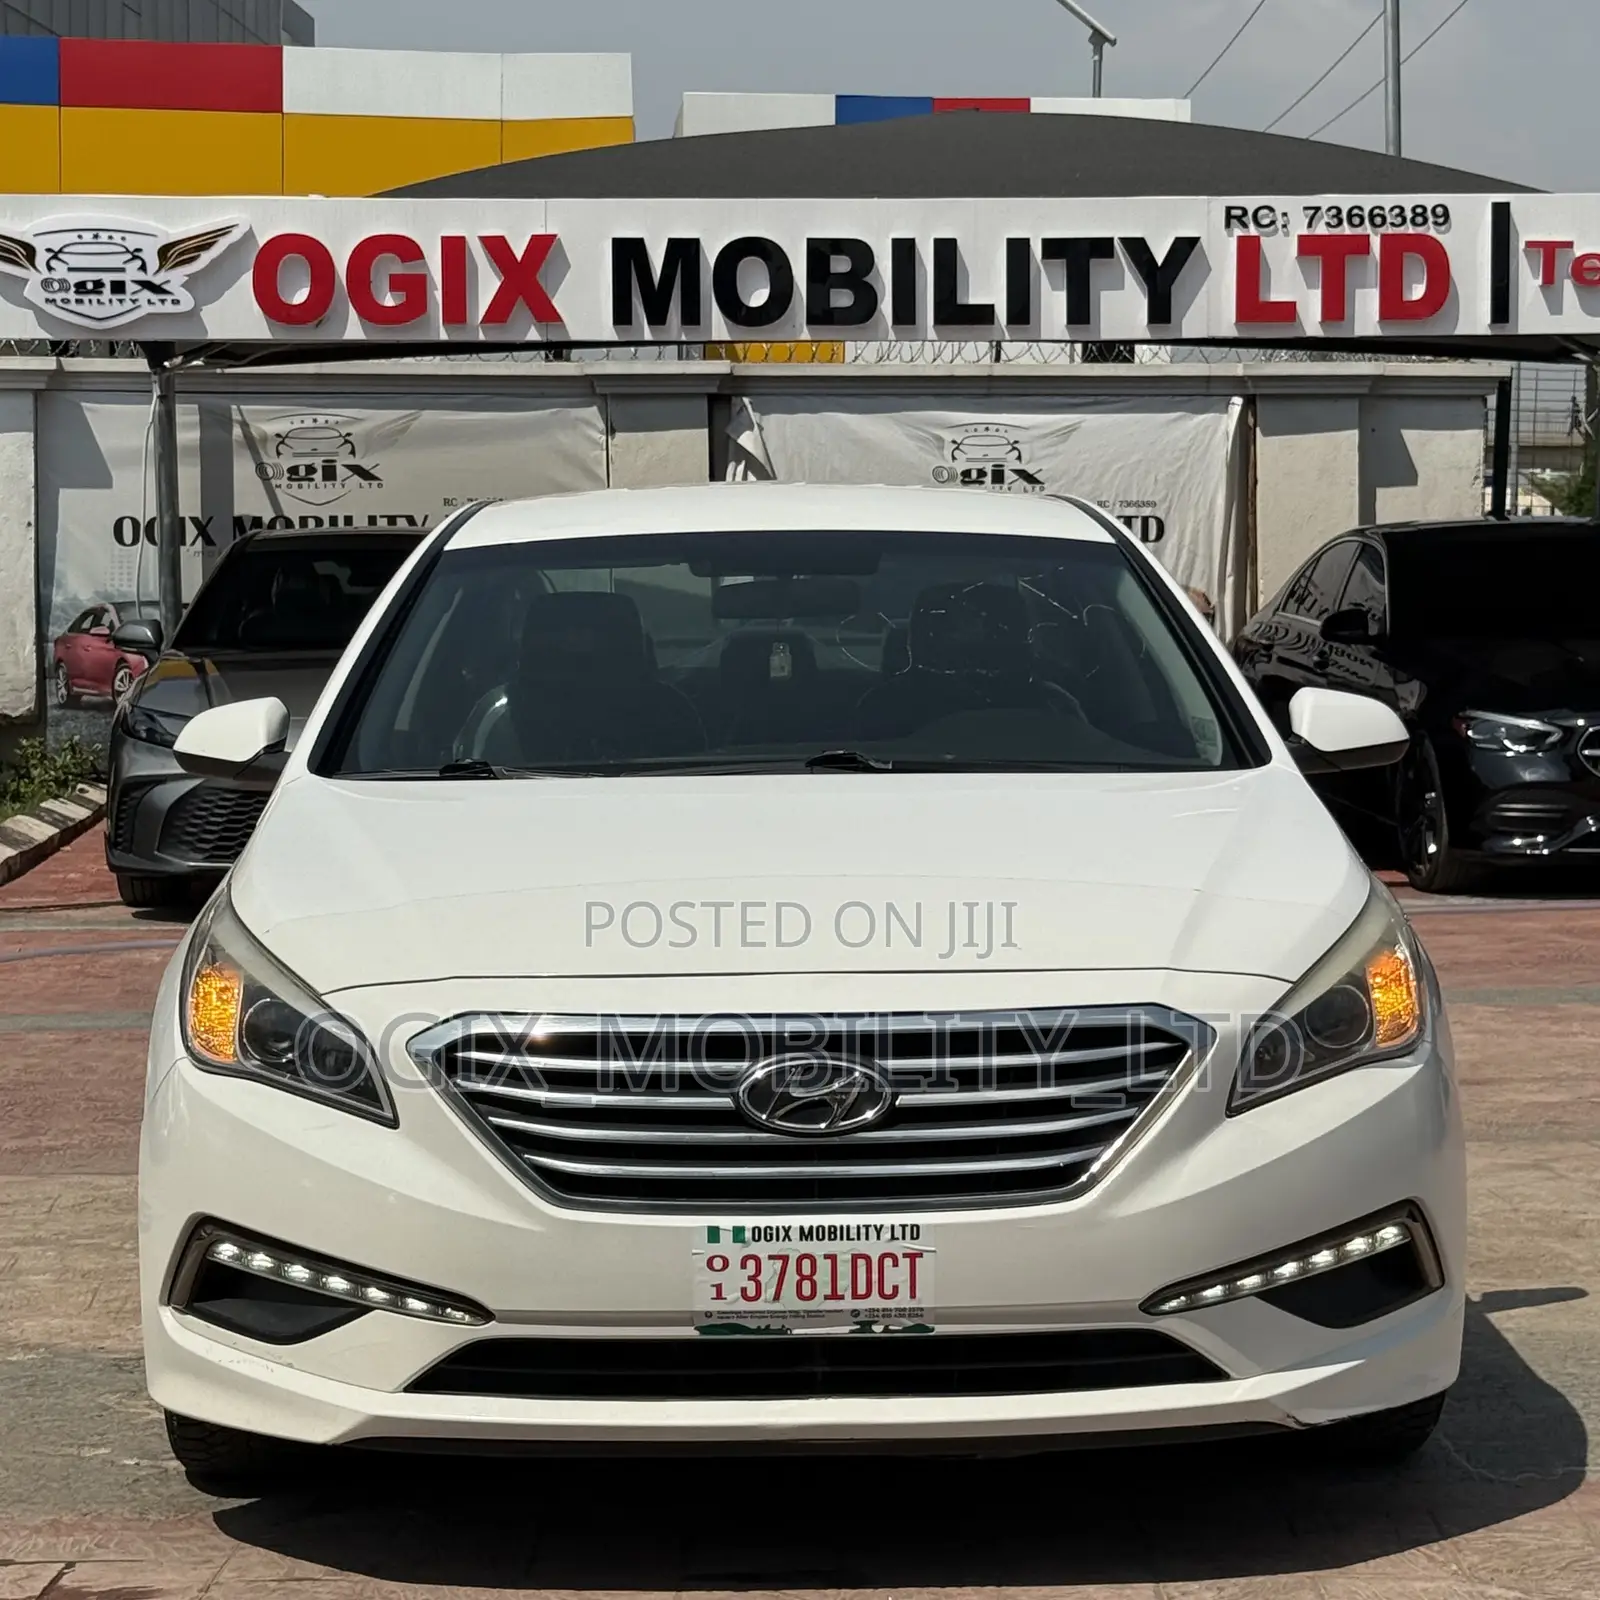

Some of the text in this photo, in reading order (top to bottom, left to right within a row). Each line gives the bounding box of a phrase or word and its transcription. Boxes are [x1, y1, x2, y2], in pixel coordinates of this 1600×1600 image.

[1224, 204, 1450, 229] RC: 7366389
[252, 233, 1450, 327] OGIX MOBILITY LTD
[44, 297, 181, 306] MOBILITY LTD
[275, 482, 346, 490] MOBILITY
[1023, 485, 1046, 493] LTD
[1116, 515, 1164, 543] TD
[751, 1223, 921, 1242] OGIX MOBILITY LTD
[740, 1252, 924, 1302] 3781DCT
